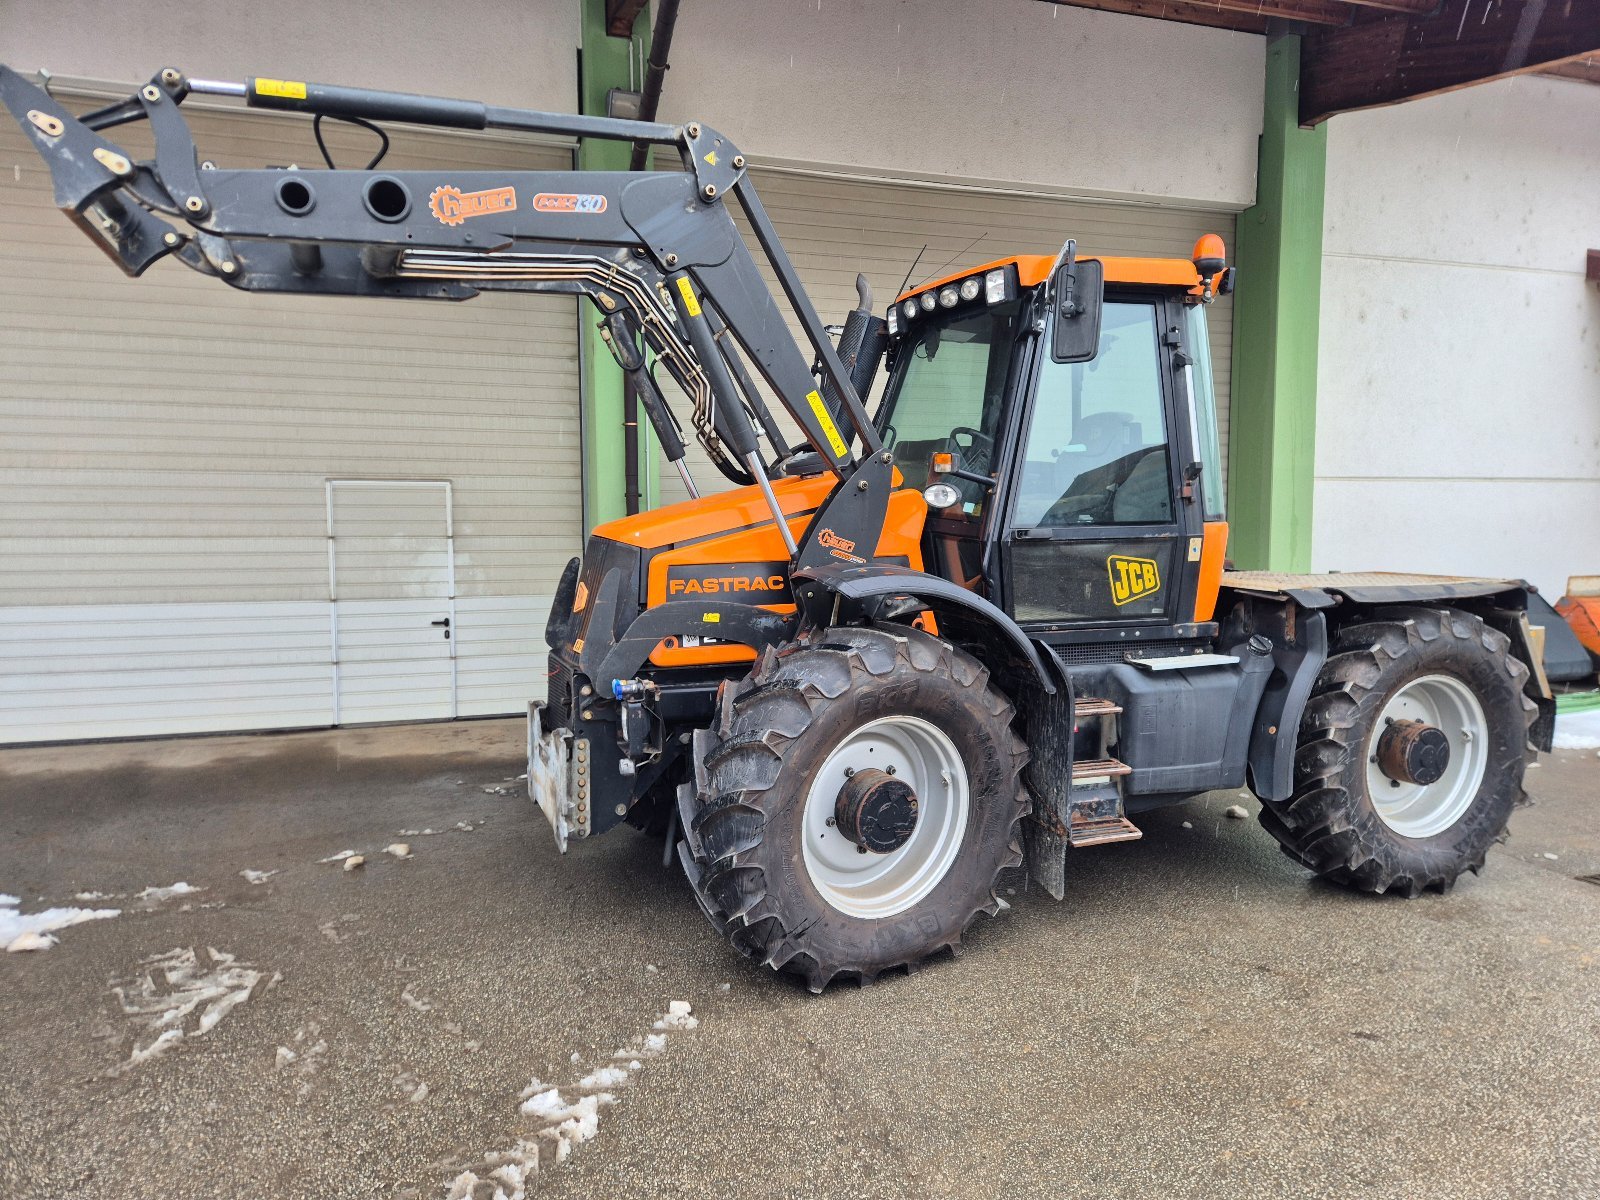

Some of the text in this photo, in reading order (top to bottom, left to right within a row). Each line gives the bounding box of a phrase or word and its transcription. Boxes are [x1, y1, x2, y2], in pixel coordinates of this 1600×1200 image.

[442, 192, 511, 216] hauer
[669, 575, 785, 594] FASTRAC
[1115, 561, 1155, 599] JCB
